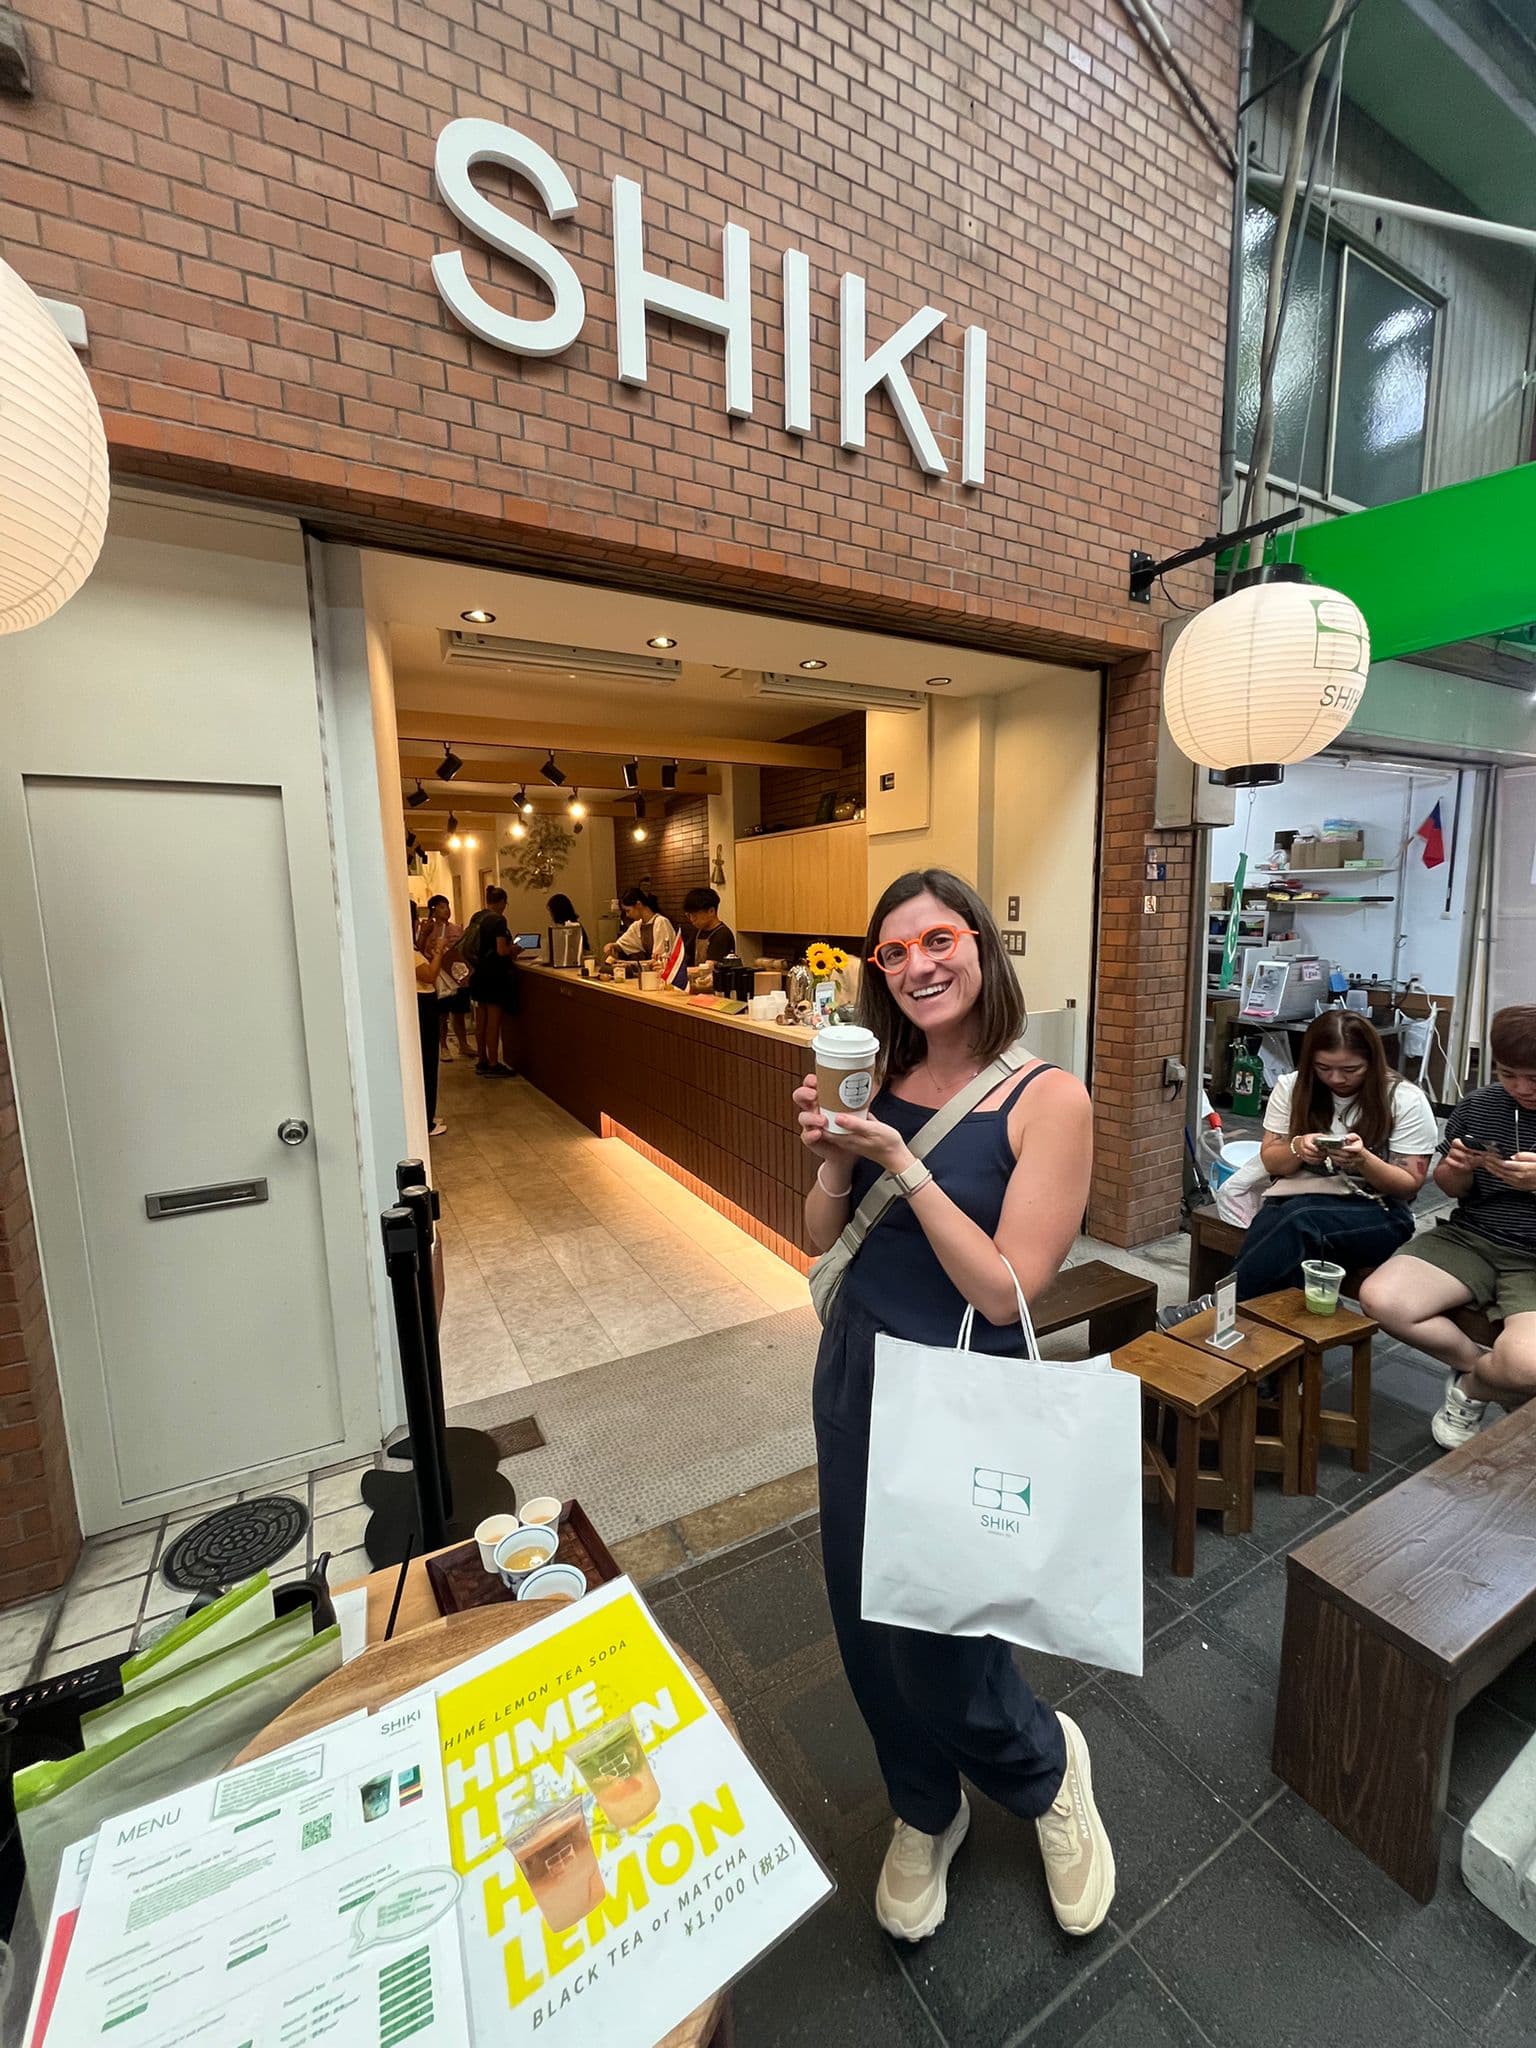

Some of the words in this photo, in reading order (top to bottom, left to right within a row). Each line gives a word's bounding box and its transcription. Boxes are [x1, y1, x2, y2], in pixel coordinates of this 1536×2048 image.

[431, 117, 987, 488] SHIKI
[980, 1514, 1020, 1534] SHIKI
[381, 1709, 421, 1735] SHIKI
[444, 1719, 487, 1751] HIME
[494, 1684, 549, 1723] LEMON
[556, 1665, 583, 1686] TEA
[589, 1640, 627, 1667] SODA
[446, 1680, 604, 1808] HIME
[116, 1807, 182, 1847] MENU
[461, 1687, 681, 1863] LEMN
[503, 1783, 745, 2011] LEMON
[532, 1964, 600, 2031] BLACK
[607, 1930, 644, 1968] TEA
[652, 1909, 670, 1931] or
[678, 1848, 748, 1912] MATCHA
